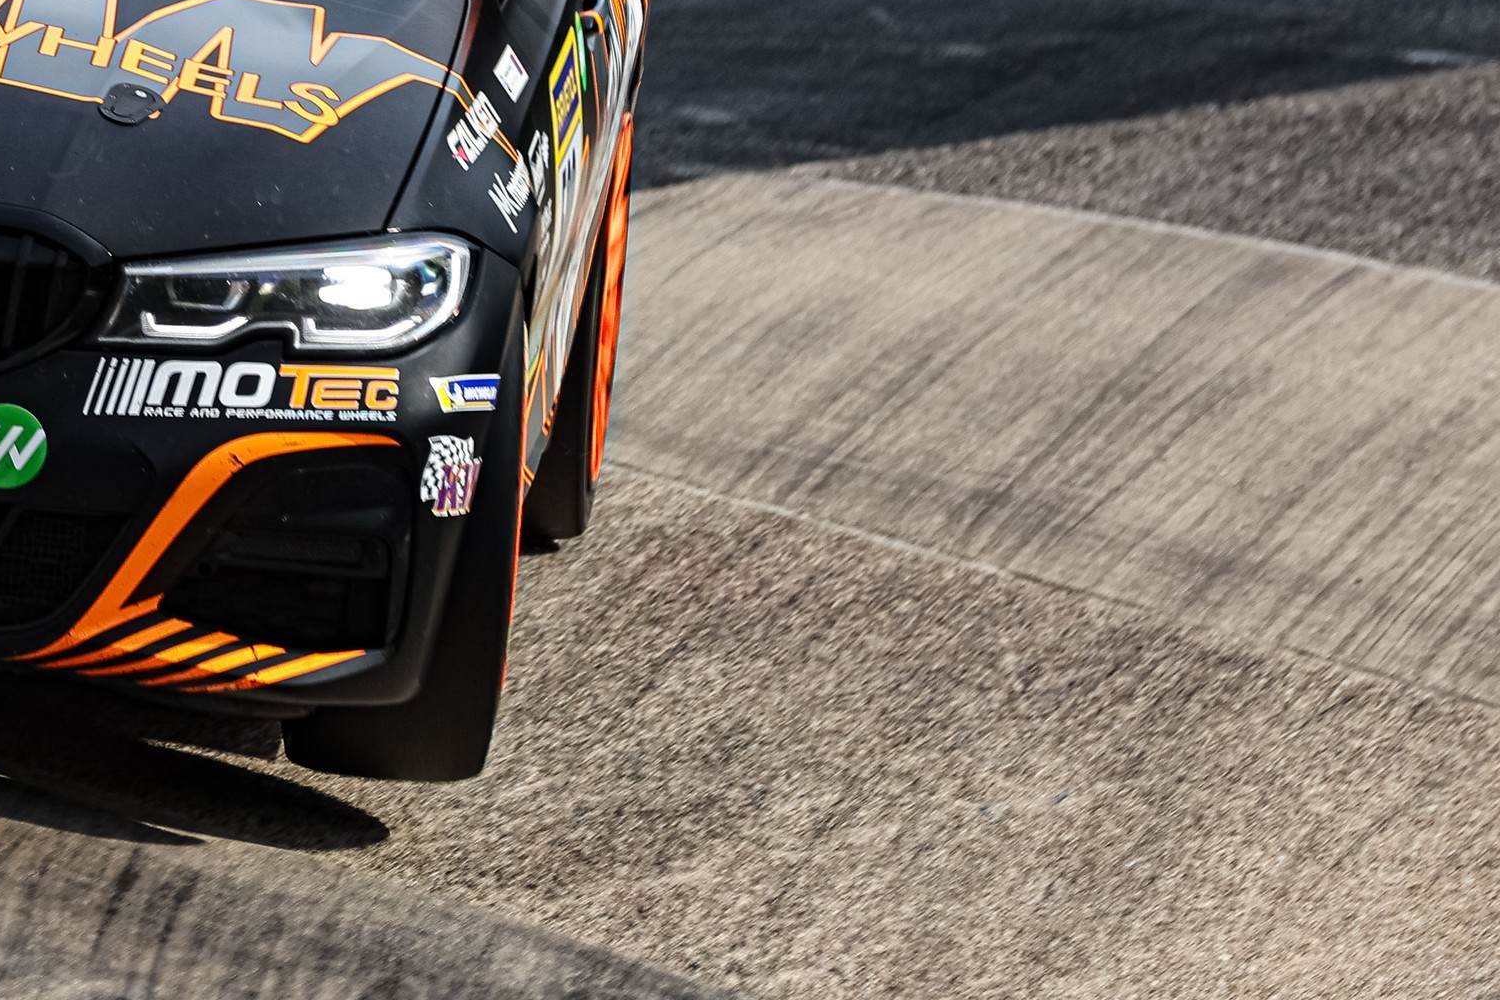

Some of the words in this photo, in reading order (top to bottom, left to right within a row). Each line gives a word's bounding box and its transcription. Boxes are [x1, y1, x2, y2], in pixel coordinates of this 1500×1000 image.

[446, 90, 502, 172] FALKEN
[143, 406, 185, 419] RACE
[190, 407, 220, 419] AND
[226, 408, 334, 421] PERFORMANCE
[338, 409, 398, 423] WHEELS
